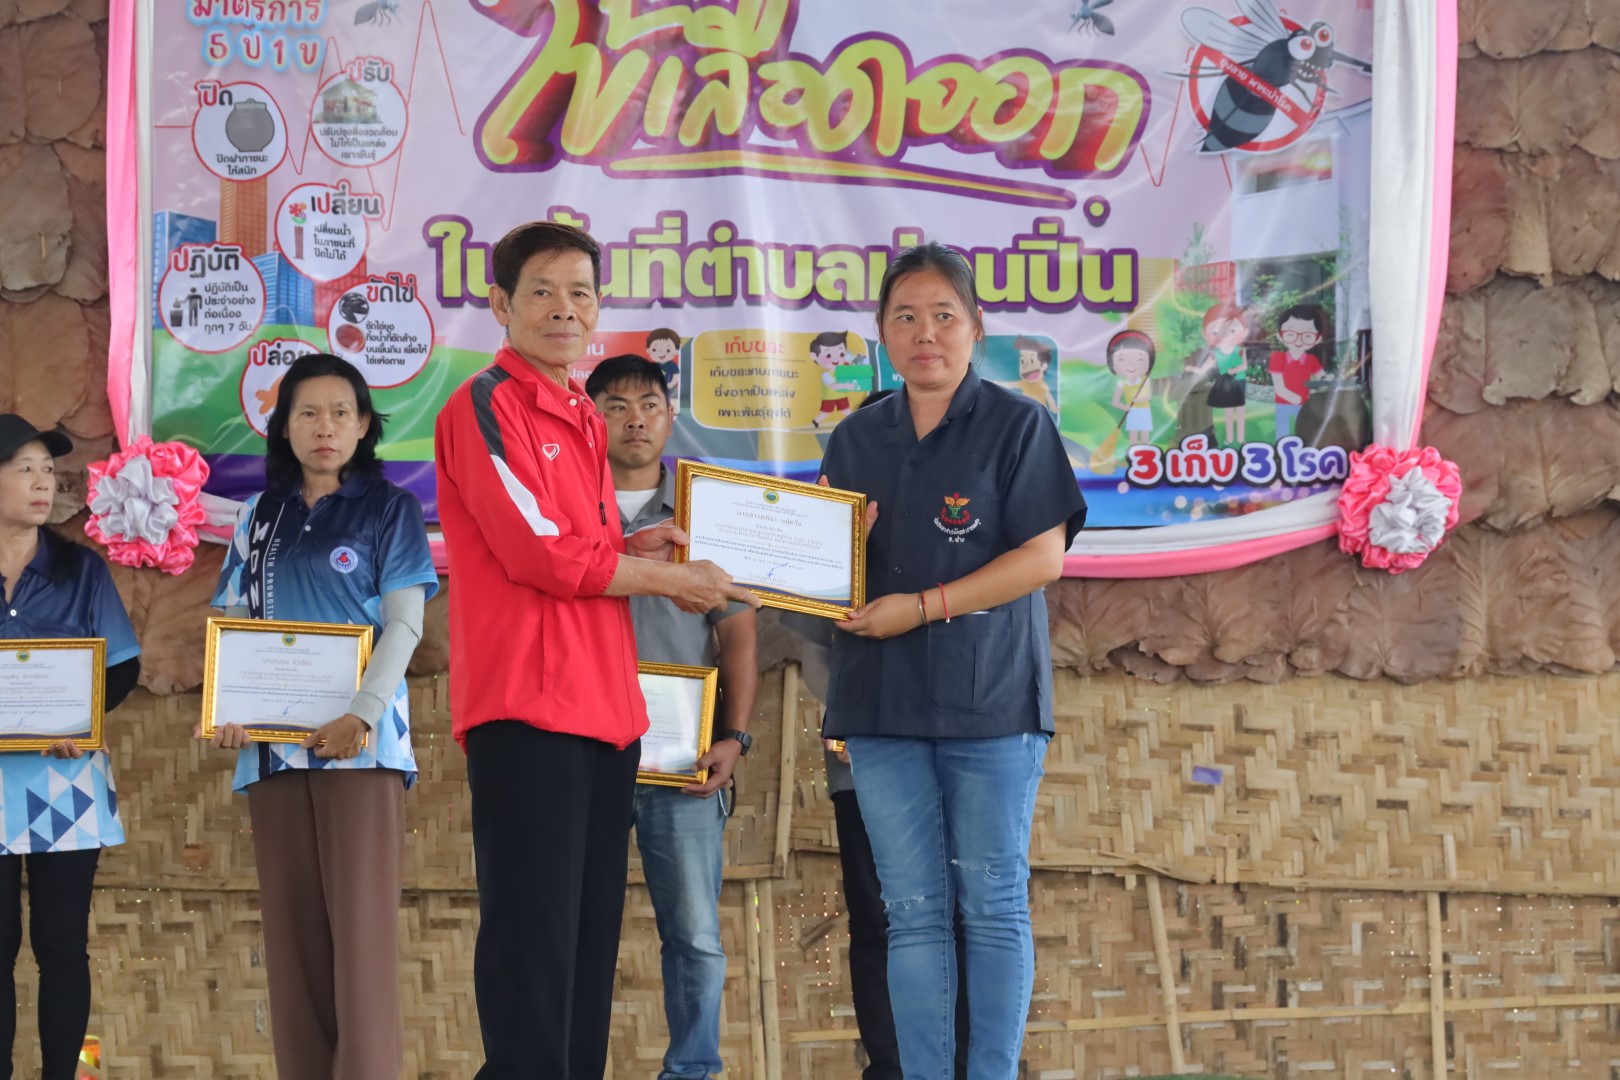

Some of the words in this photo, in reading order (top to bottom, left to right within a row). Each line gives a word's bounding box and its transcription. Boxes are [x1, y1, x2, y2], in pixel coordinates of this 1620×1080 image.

[193, 0, 320, 22] มาตรการ
[209, 33, 228, 59] 5
[243, 34, 261, 60] ป
[273, 39, 284, 65] 1
[350, 60, 390, 82] ปรับ
[199, 84, 233, 107] ปิด
[215, 153, 268, 163] ปิดฝาภาชนะ
[227, 164, 257, 175] ให้สนิท
[311, 184, 380, 215] เปลี่ยน
[314, 221, 351, 235] เปลี่ยนน้ำ
[313, 233, 355, 248] ในภาชนะที่
[173, 246, 240, 278] ปฏิบัติ
[313, 247, 346, 260] ปิดไม่ได้
[204, 281, 249, 295] ปฏิบัติเป็น
[366, 275, 414, 303] ขัดไข่
[204, 294, 256, 306] ประจำอย่าง
[204, 306, 241, 319] ต่อเนื่อง
[228, 323, 235, 332] 7
[366, 320, 395, 333] ขัดไข่ยุง
[253, 342, 311, 366] ปล่อ
[725, 335, 784, 354] เก็บขยะ
[1132, 449, 1159, 480] 3
[1170, 438, 1235, 479] เก็บ
[1245, 446, 1273, 479] 3
[1281, 440, 1345, 478] โรค
[267, 537, 282, 567] HEALTH
